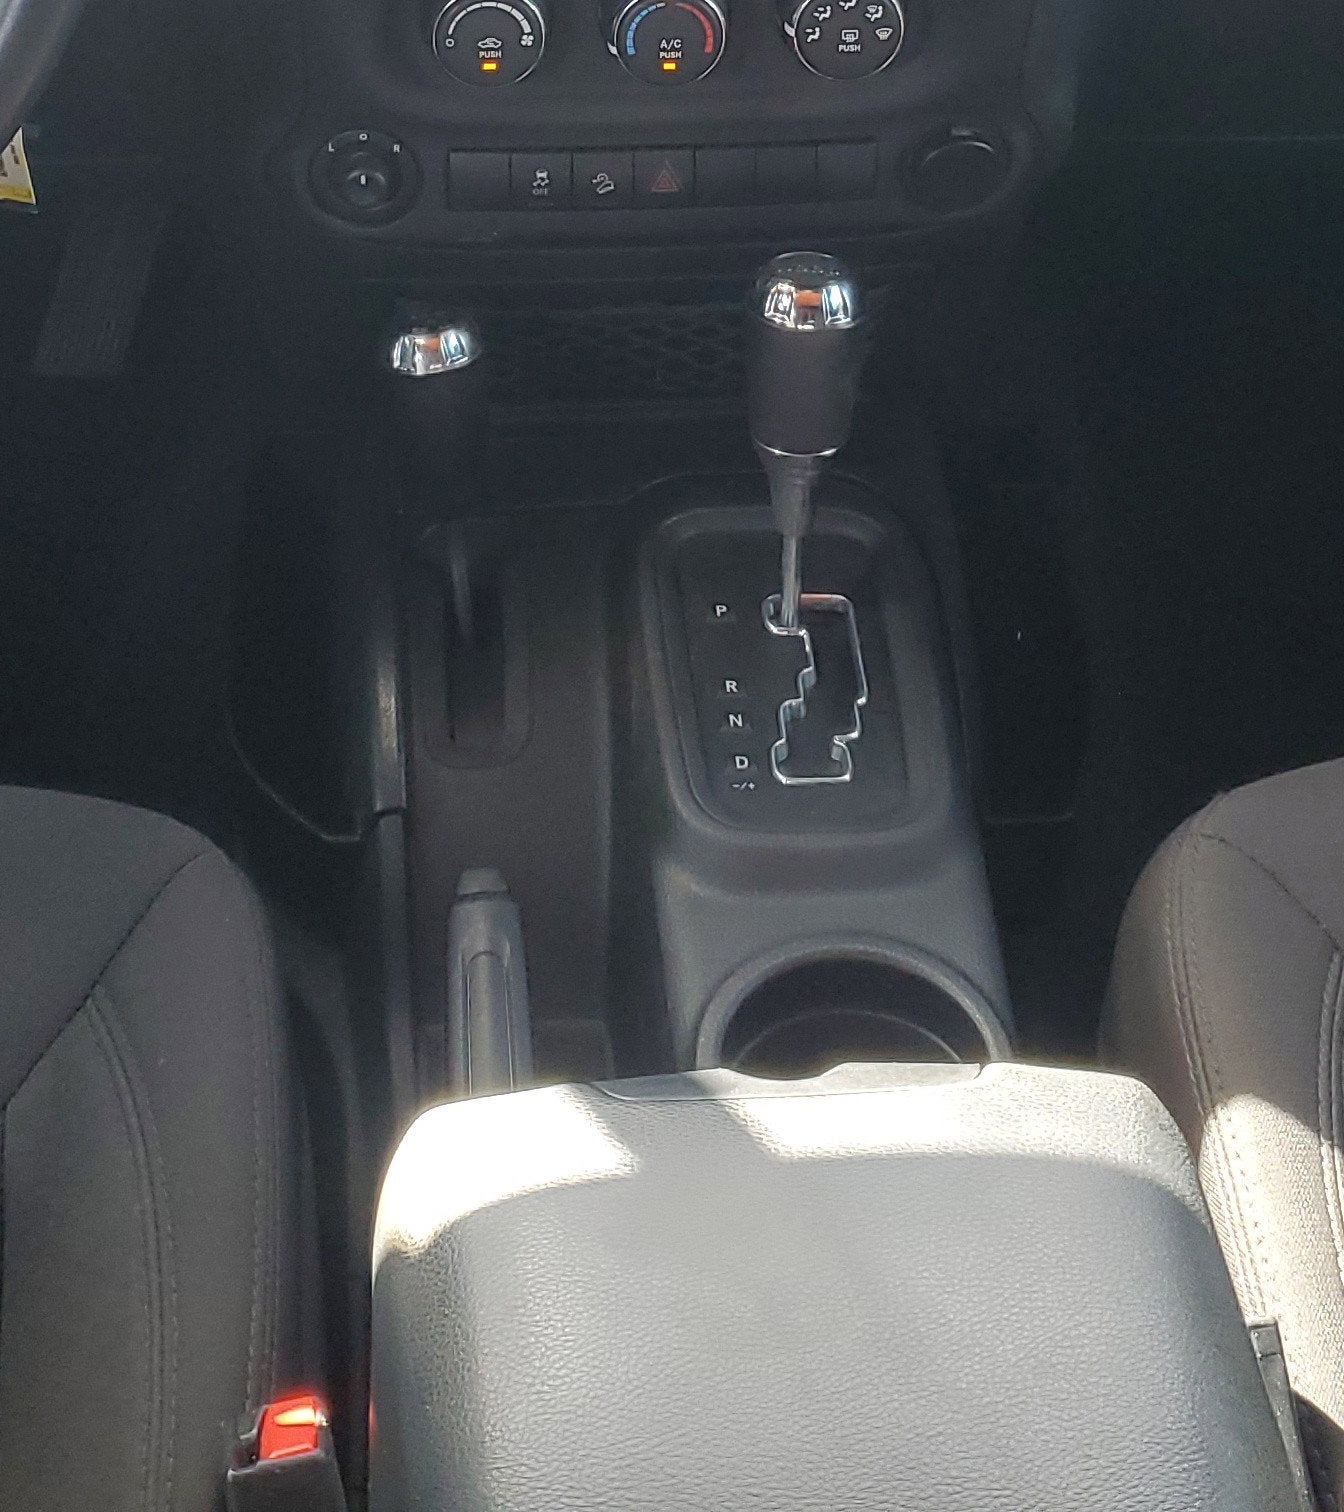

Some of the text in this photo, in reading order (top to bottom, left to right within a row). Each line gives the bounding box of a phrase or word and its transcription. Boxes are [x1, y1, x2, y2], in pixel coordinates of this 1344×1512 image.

[660, 39, 682, 50] A/C
[838, 44, 861, 53] PUSH
[479, 50, 502, 59] PUSH
[659, 51, 682, 59] PUSH
[328, 142, 335, 152] L
[532, 188, 548, 196] OFF
[715, 604, 728, 617] P
[725, 680, 739, 694] R
[729, 714, 744, 728] N
[735, 755, 749, 769] D
